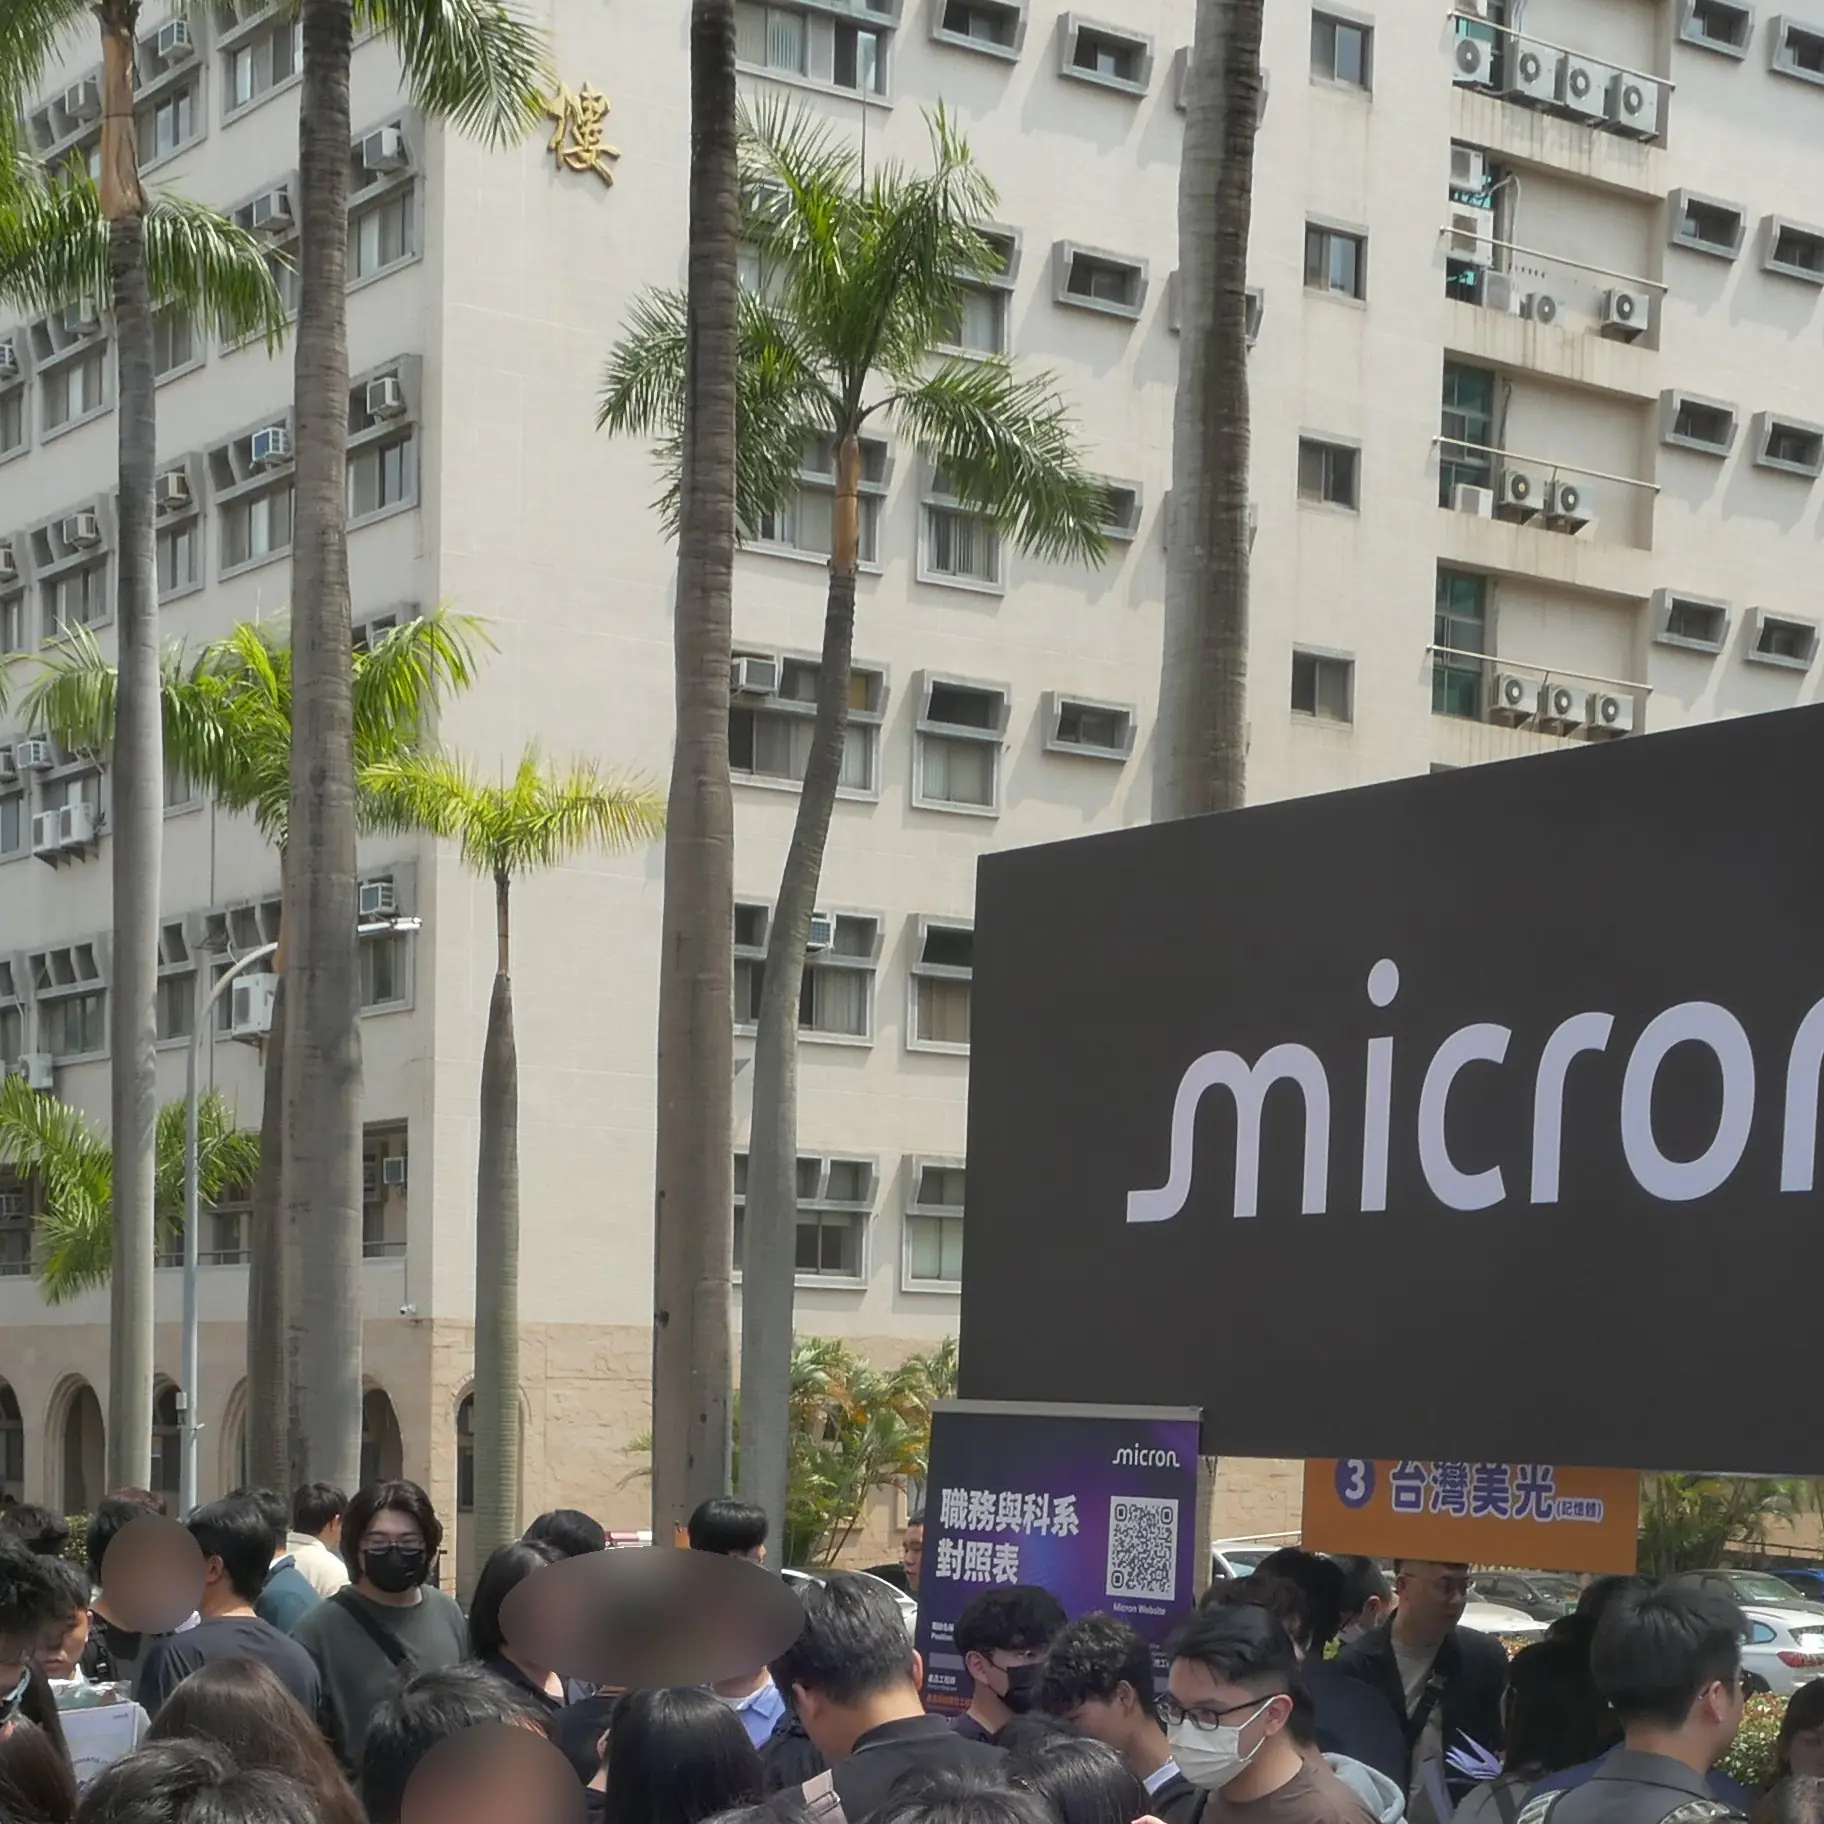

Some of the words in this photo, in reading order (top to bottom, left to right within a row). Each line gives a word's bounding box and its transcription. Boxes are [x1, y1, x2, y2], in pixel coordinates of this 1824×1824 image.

[1112, 1442, 1181, 1468] micron
[939, 1487, 1080, 1538] 職務與科系
[1343, 1459, 1366, 1501] 3
[1390, 1459, 1555, 1523] 台灣美光
[935, 1537, 1021, 1585] 對照表
[1112, 1602, 1136, 1614] Micron
[1138, 1604, 1167, 1617] Website
